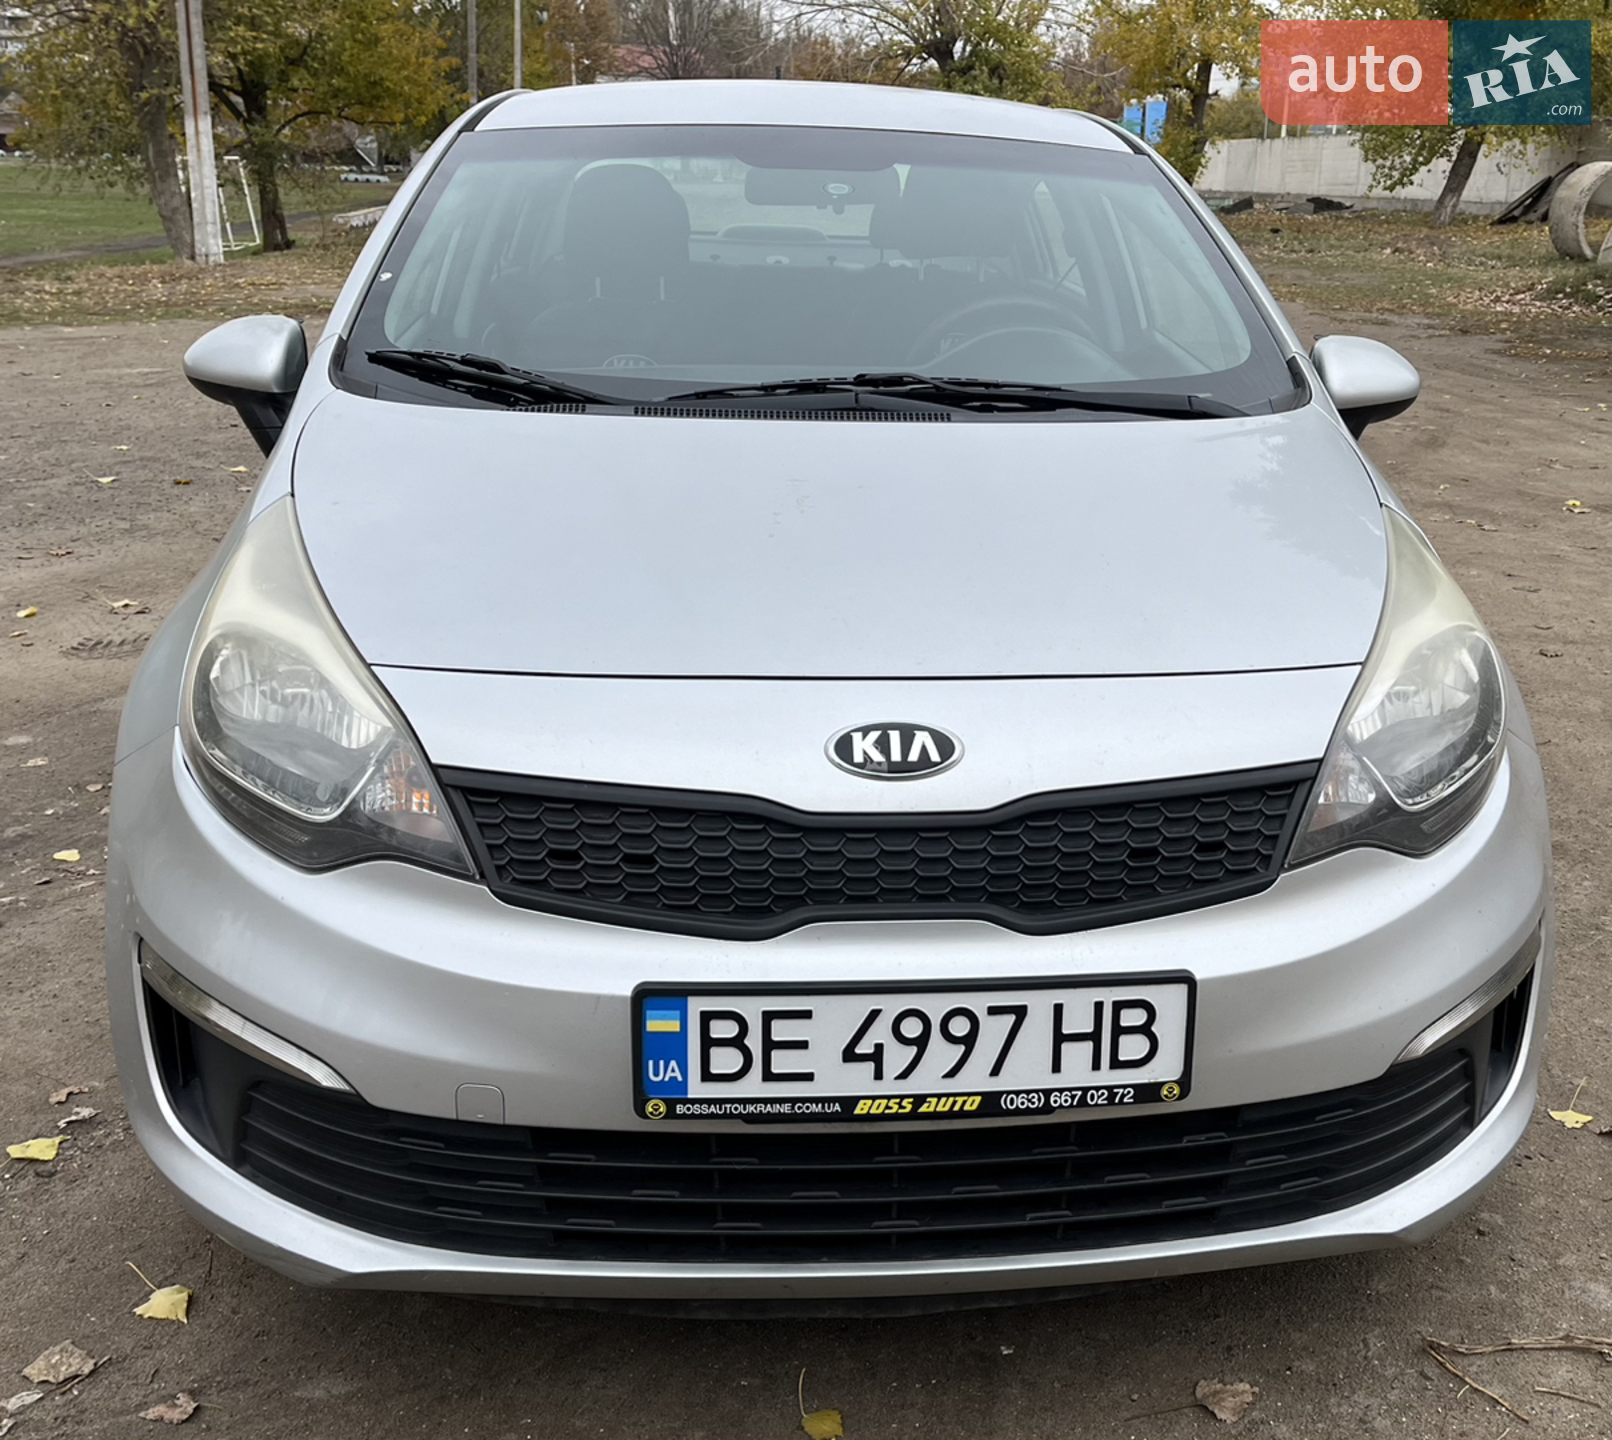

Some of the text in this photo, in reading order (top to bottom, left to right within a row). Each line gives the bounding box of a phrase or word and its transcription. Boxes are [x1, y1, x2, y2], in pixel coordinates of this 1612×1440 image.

[850, 730, 942, 763] KIA
[700, 998, 1160, 1083] BE 4997 HB
[648, 1060, 683, 1082] UA
[676, 1102, 842, 1115] BOSSAUTOUKRAINE.COM.UA
[853, 1097, 914, 1115] BOSS
[1000, 1092, 1045, 1110] (063)
[1050, 1090, 1082, 1107] 667
[1087, 1089, 1108, 1105] 02
[1113, 1087, 1134, 1103] 72
